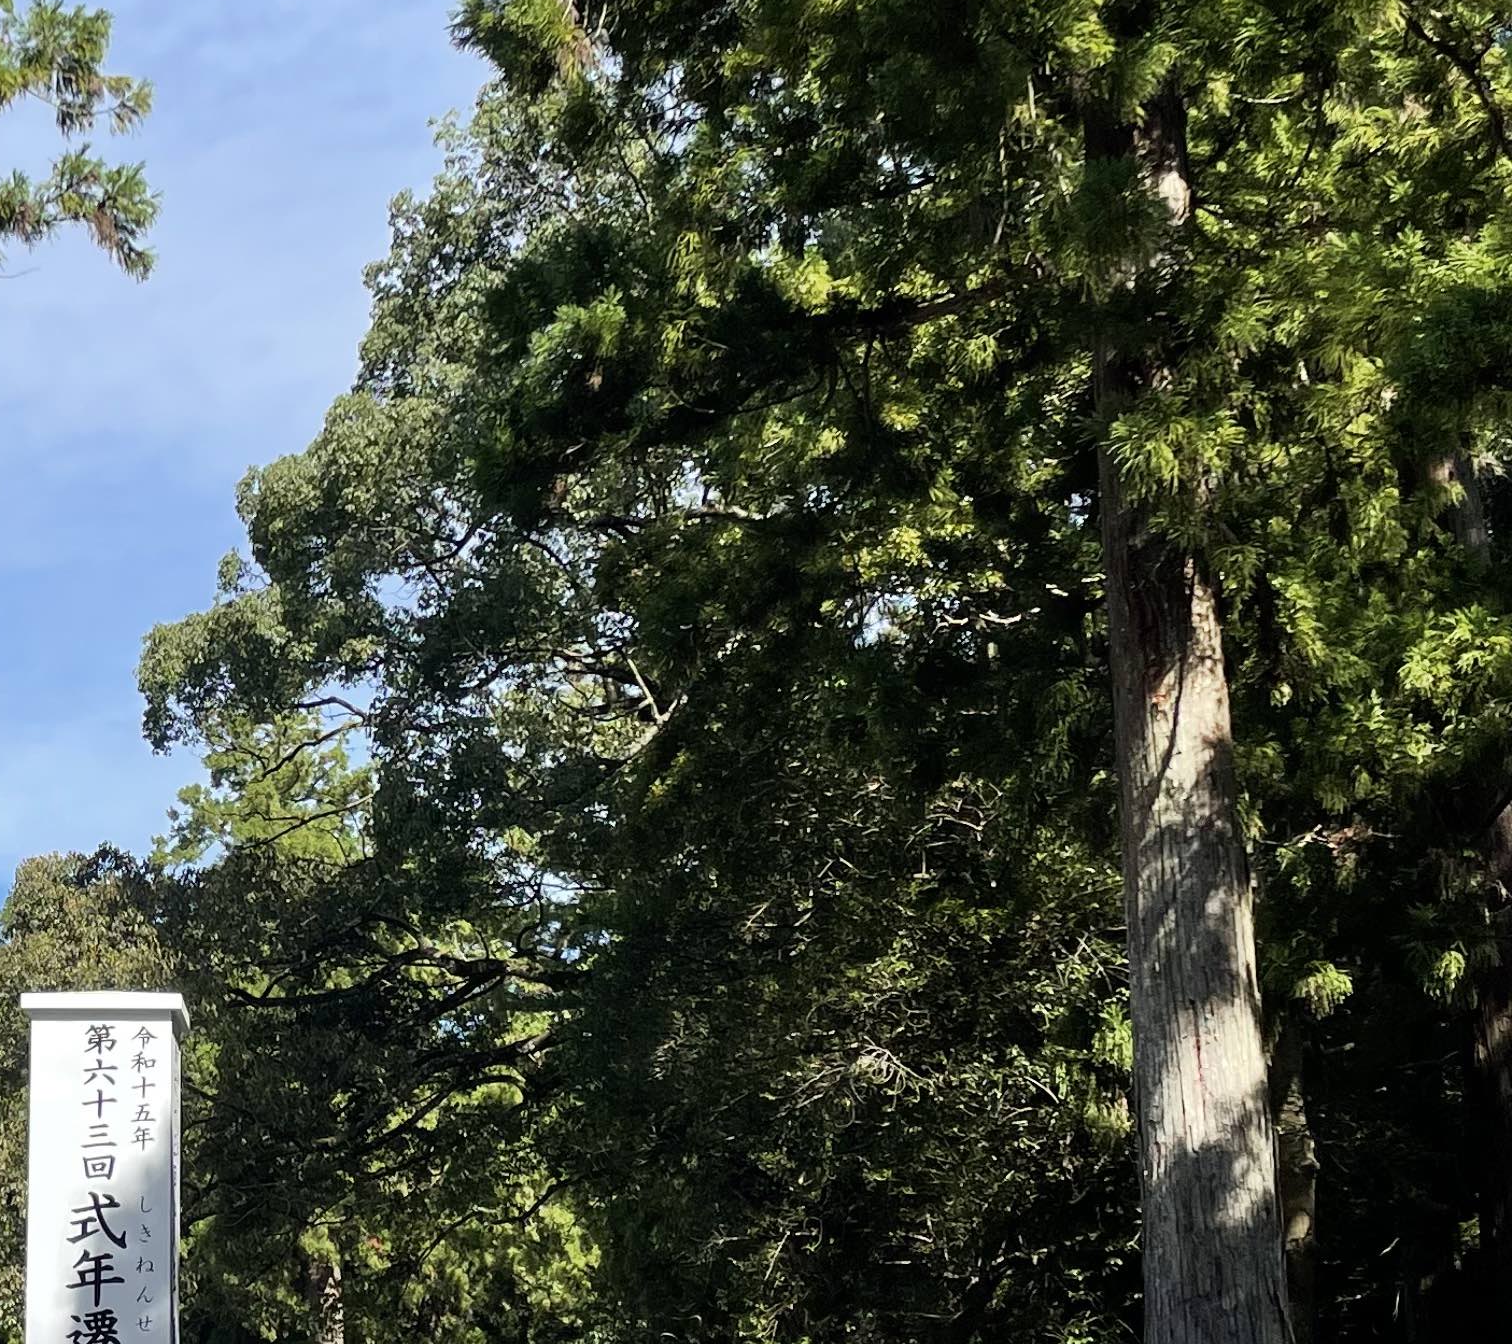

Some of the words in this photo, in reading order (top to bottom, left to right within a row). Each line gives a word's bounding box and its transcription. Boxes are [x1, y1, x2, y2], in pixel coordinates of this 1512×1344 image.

[132, 1027, 156, 1150] 令和十五年
